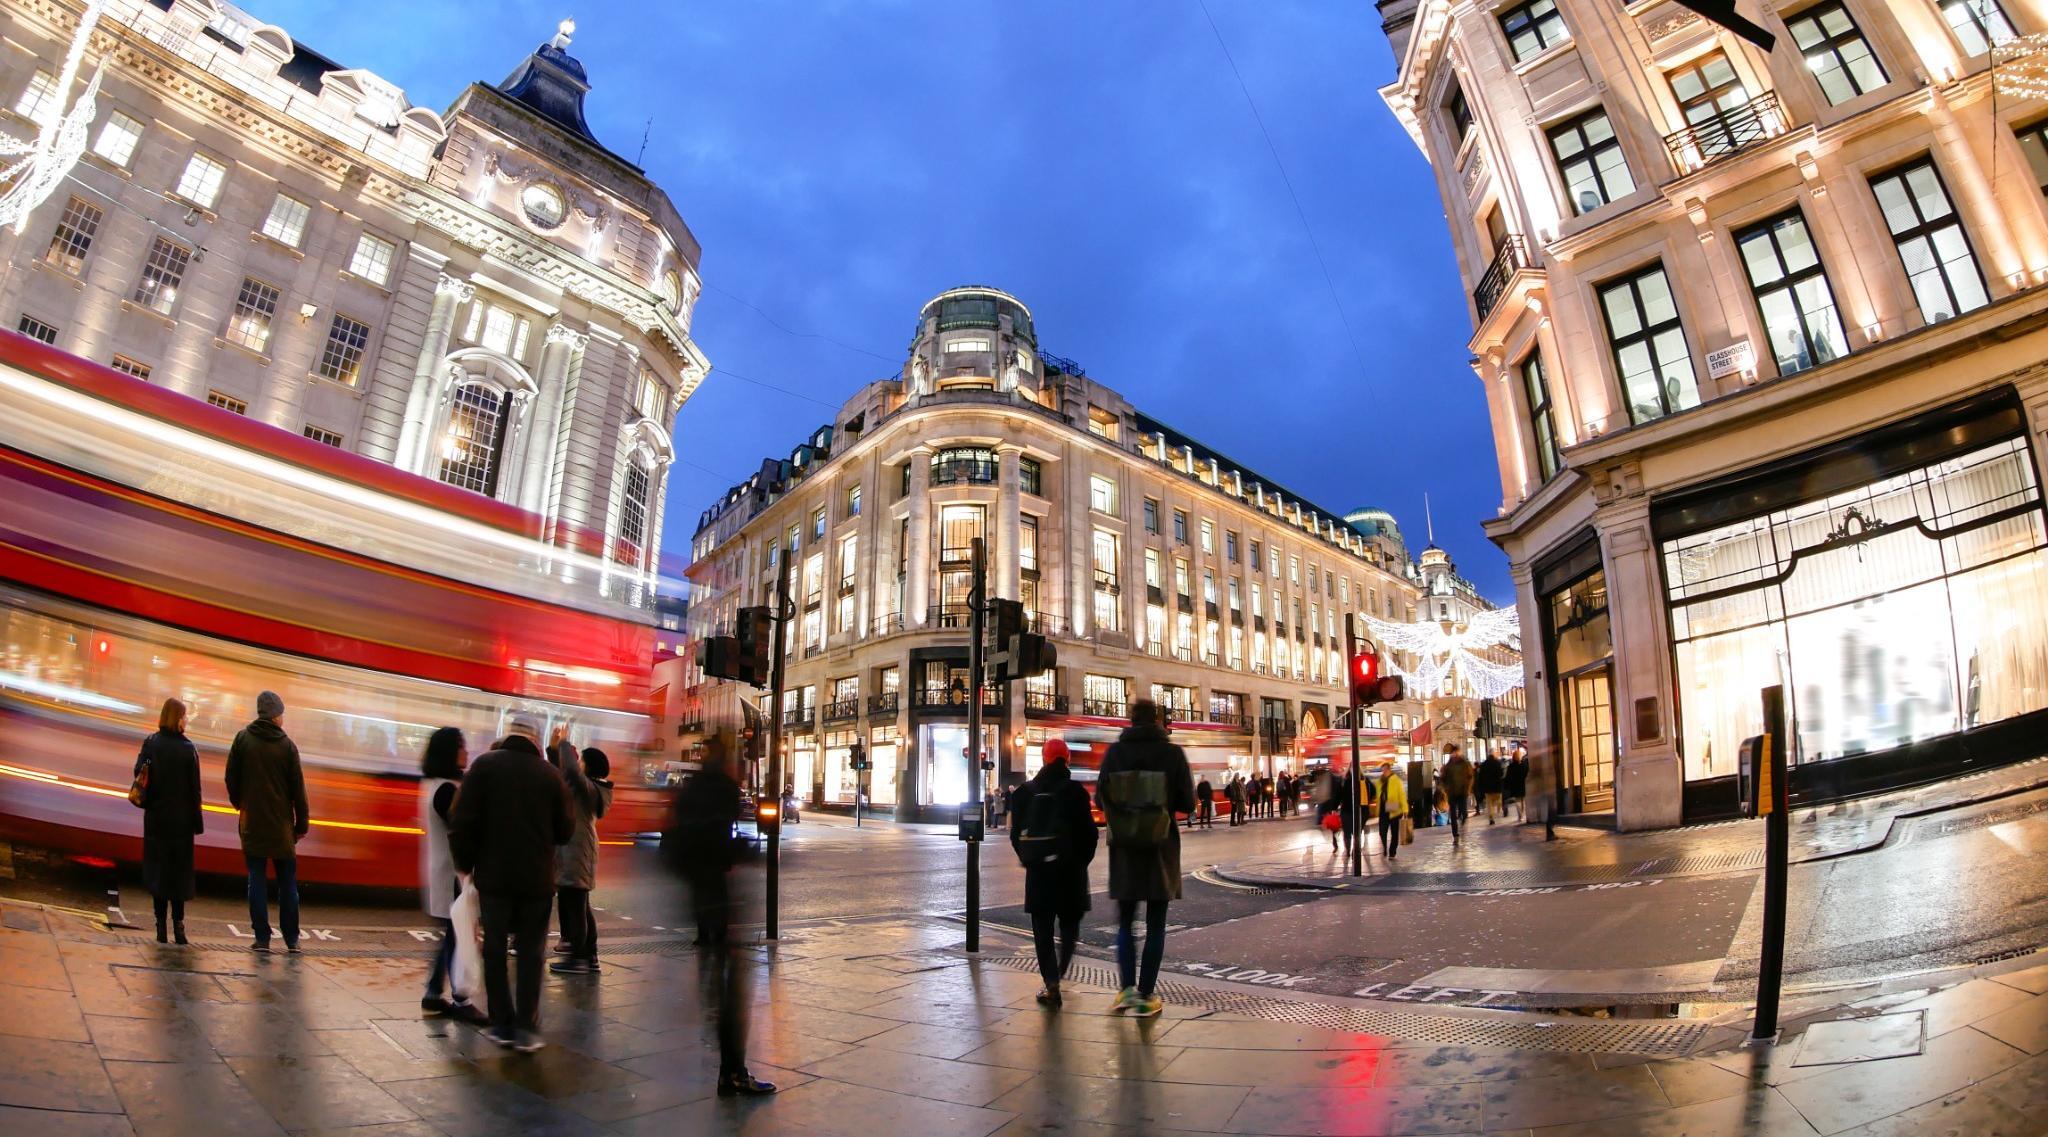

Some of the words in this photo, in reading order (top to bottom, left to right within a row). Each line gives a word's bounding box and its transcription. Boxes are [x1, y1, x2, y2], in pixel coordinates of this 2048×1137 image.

[1709, 344, 1748, 363] GLASSHOUSE
[1711, 357, 1733, 370] STREET
[1576, 878, 1664, 892] LOOK
[1203, 966, 1317, 987] LOOK
[1354, 982, 1518, 1006] LEFT
